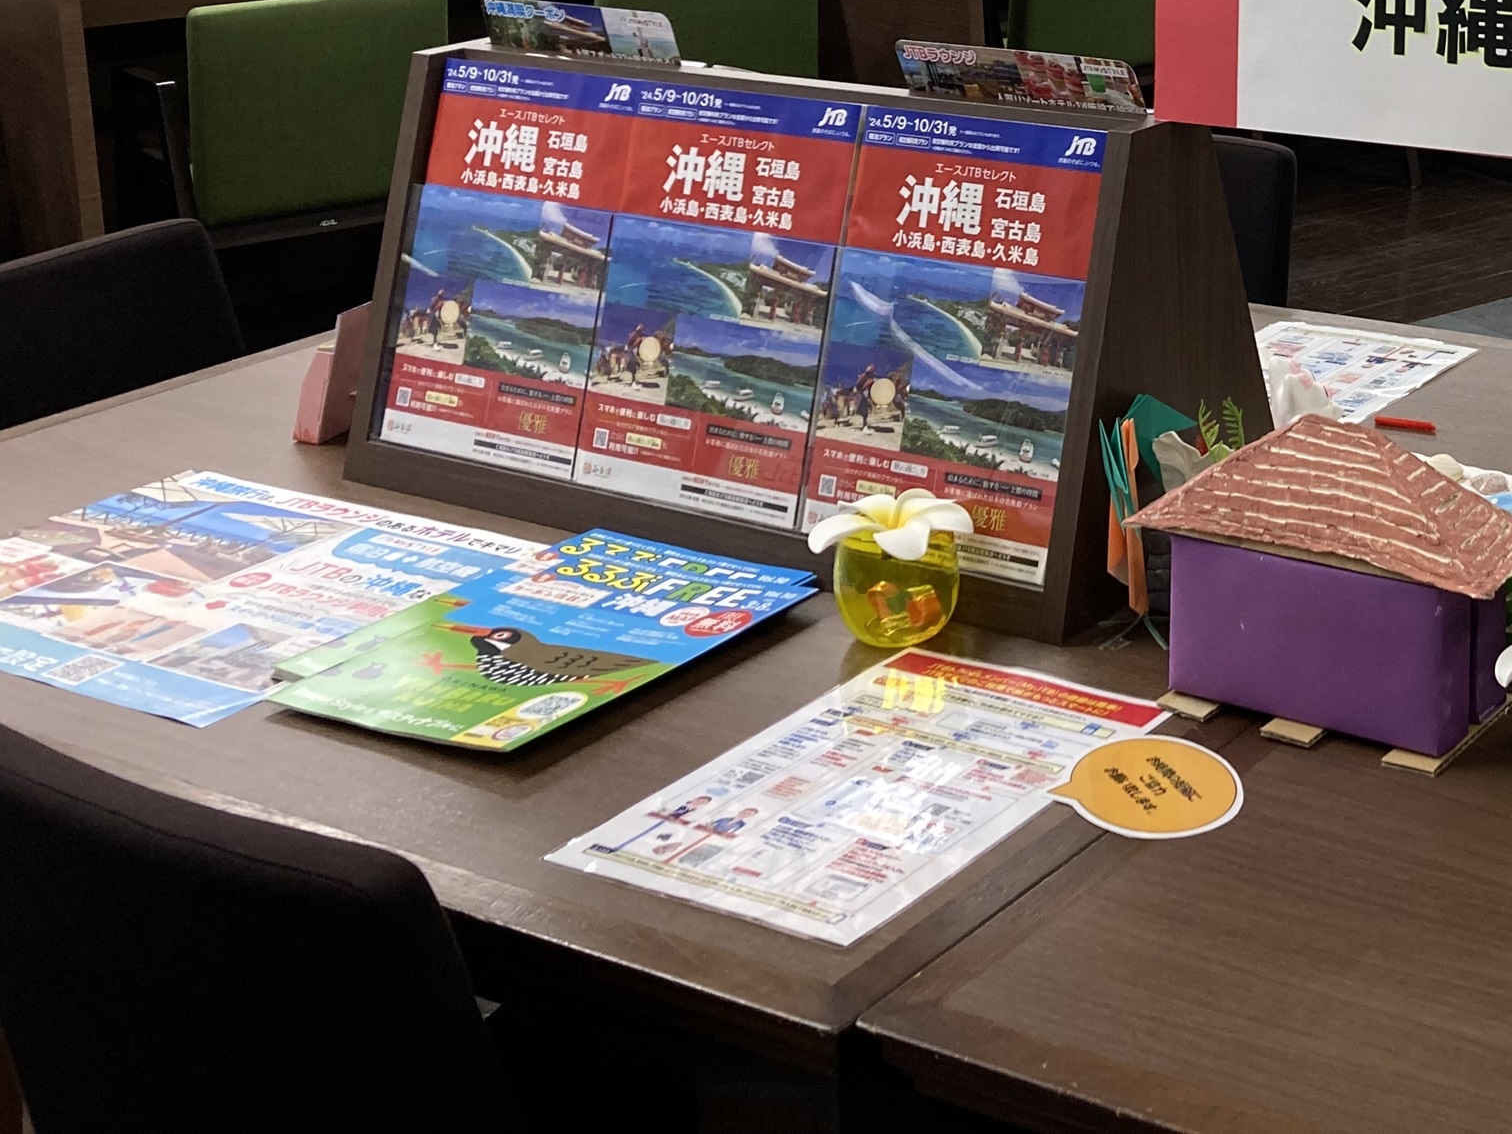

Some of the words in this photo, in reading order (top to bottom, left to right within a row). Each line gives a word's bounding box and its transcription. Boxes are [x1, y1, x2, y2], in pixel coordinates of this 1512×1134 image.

[903, 45, 977, 65] JTBラウンジ
[605, 83, 632, 102] JTB
[499, 108, 566, 126] エースJTBセレクト
[818, 107, 848, 127] JTB
[464, 119, 539, 172] 沖縄
[548, 130, 588, 153] 石垣島
[701, 134, 775, 151] エースJTBセレクト
[1065, 135, 1097, 156] JTB
[543, 156, 583, 179] 宮古島
[662, 144, 747, 202] 沖縄
[756, 157, 800, 181] 石垣島
[935, 163, 1017, 182] エースJTBセレクト
[752, 186, 795, 208] 宮古島
[896, 174, 984, 236] 沖縄
[994, 188, 1047, 214] 石垣島
[990, 217, 1042, 244] 宮古島
[518, 411, 548, 434] 優雅
[728, 455, 760, 479] 優雅
[972, 504, 1007, 531] 優雅
